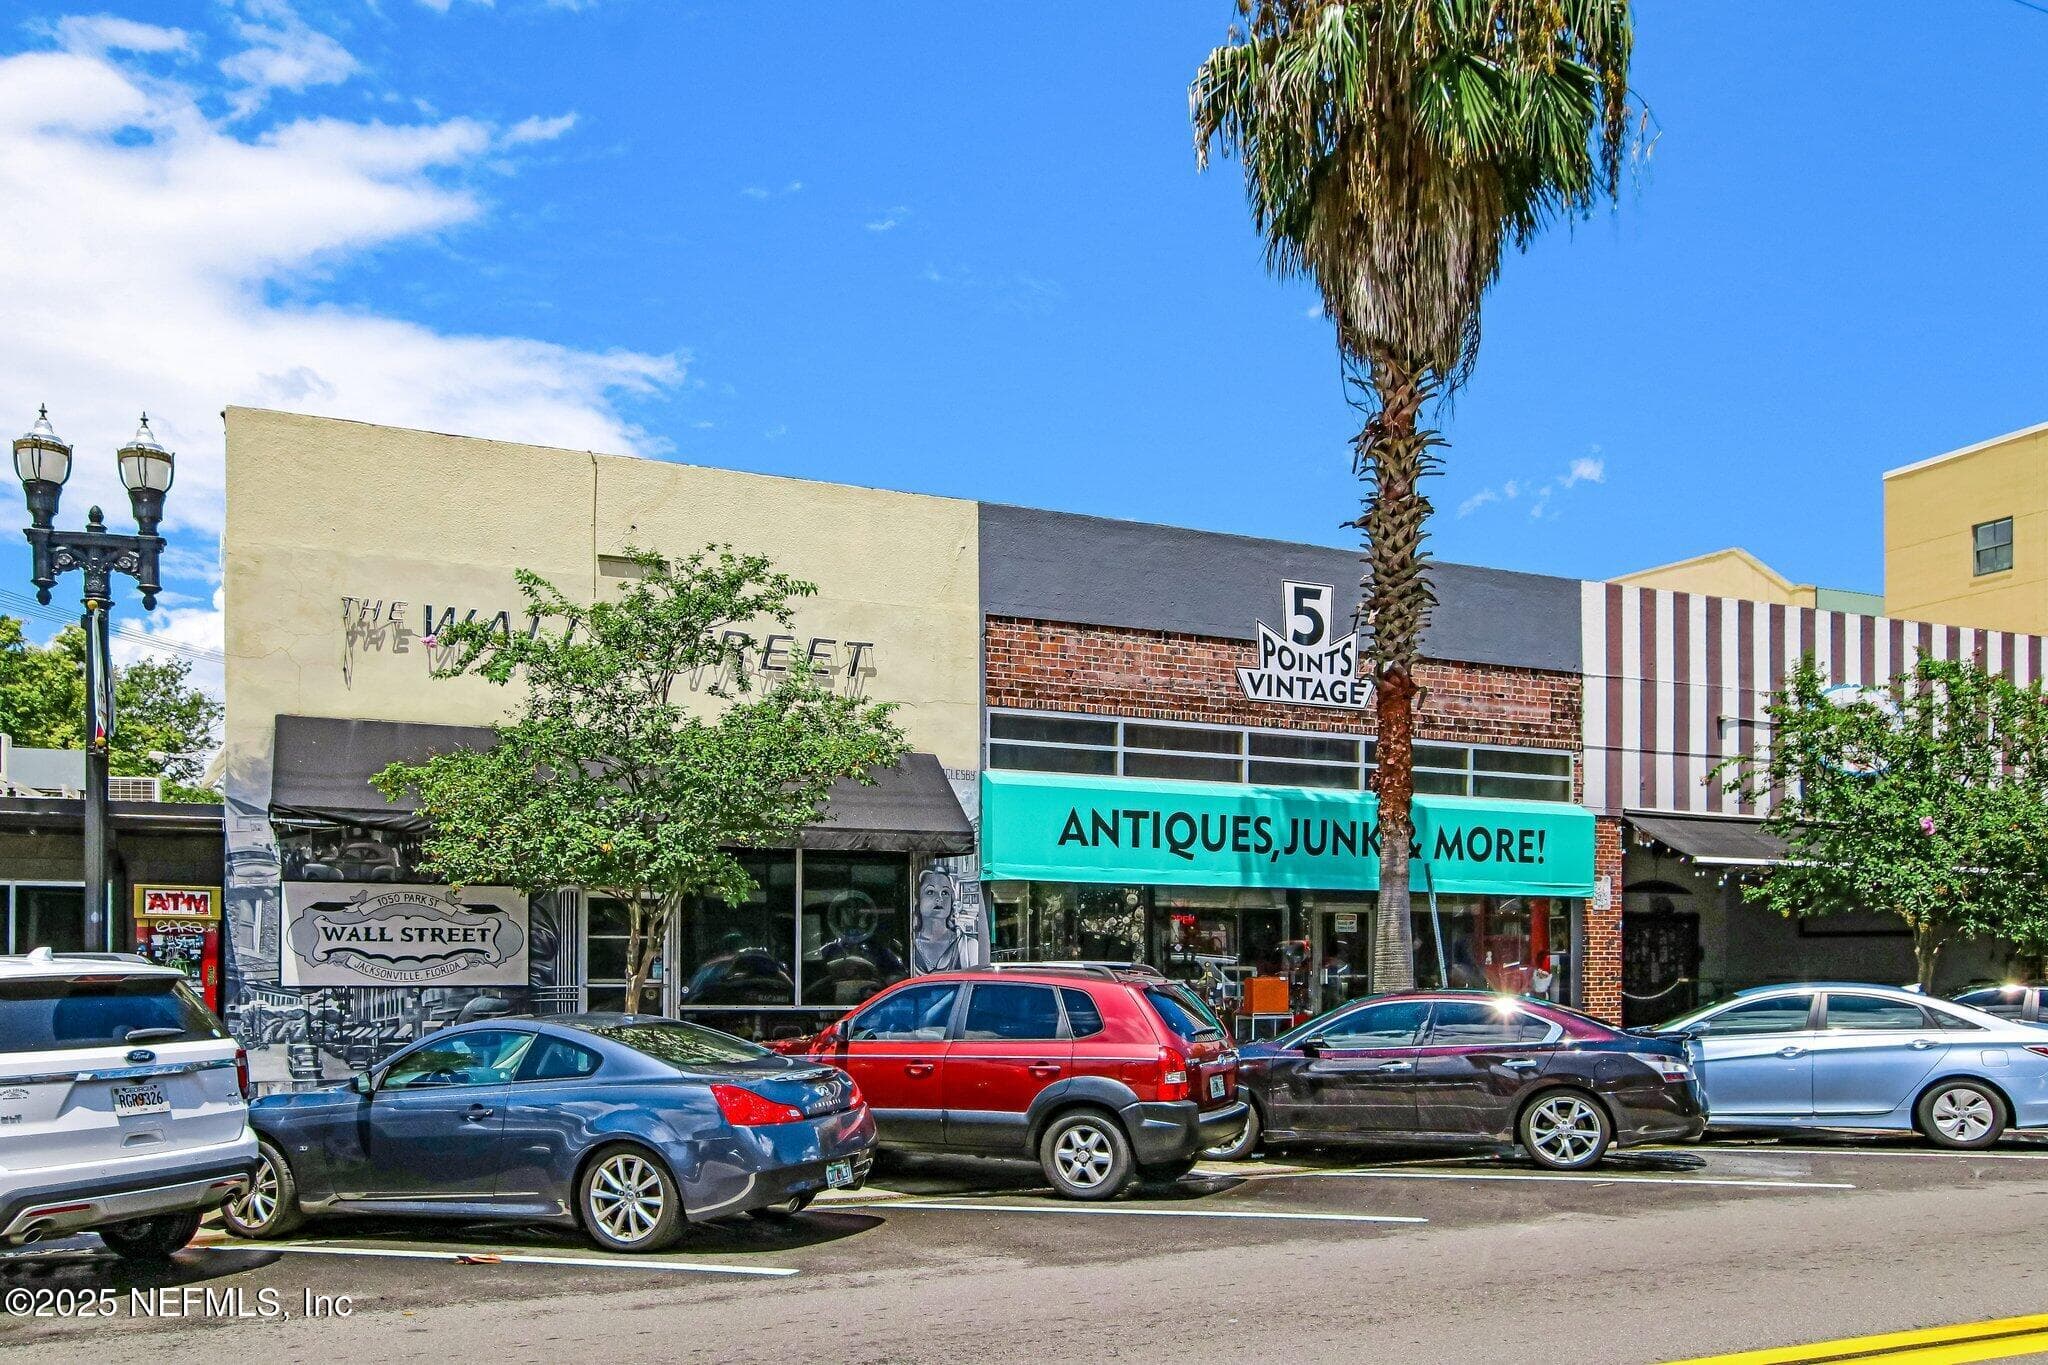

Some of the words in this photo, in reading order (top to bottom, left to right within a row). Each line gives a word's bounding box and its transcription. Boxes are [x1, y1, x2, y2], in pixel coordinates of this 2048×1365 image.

[341, 596, 408, 622] THE
[1292, 586, 1324, 646] 5
[1262, 631, 1352, 677] POINTS
[1247, 672, 1367, 705] VINTAGE
[1057, 806, 1280, 863] ANTIQUES,
[1283, 817, 1381, 858] JUNK
[1433, 824, 1546, 865] MORE!
[147, 892, 209, 915] ATM
[377, 893, 400, 906] 1050
[404, 893, 427, 905] PARK
[428, 897, 439, 908] ST
[321, 926, 393, 942] WALL
[400, 927, 491, 945] STREET
[425, 961, 461, 977] FLORIDA
[118, 1091, 164, 1109] RGR9326
